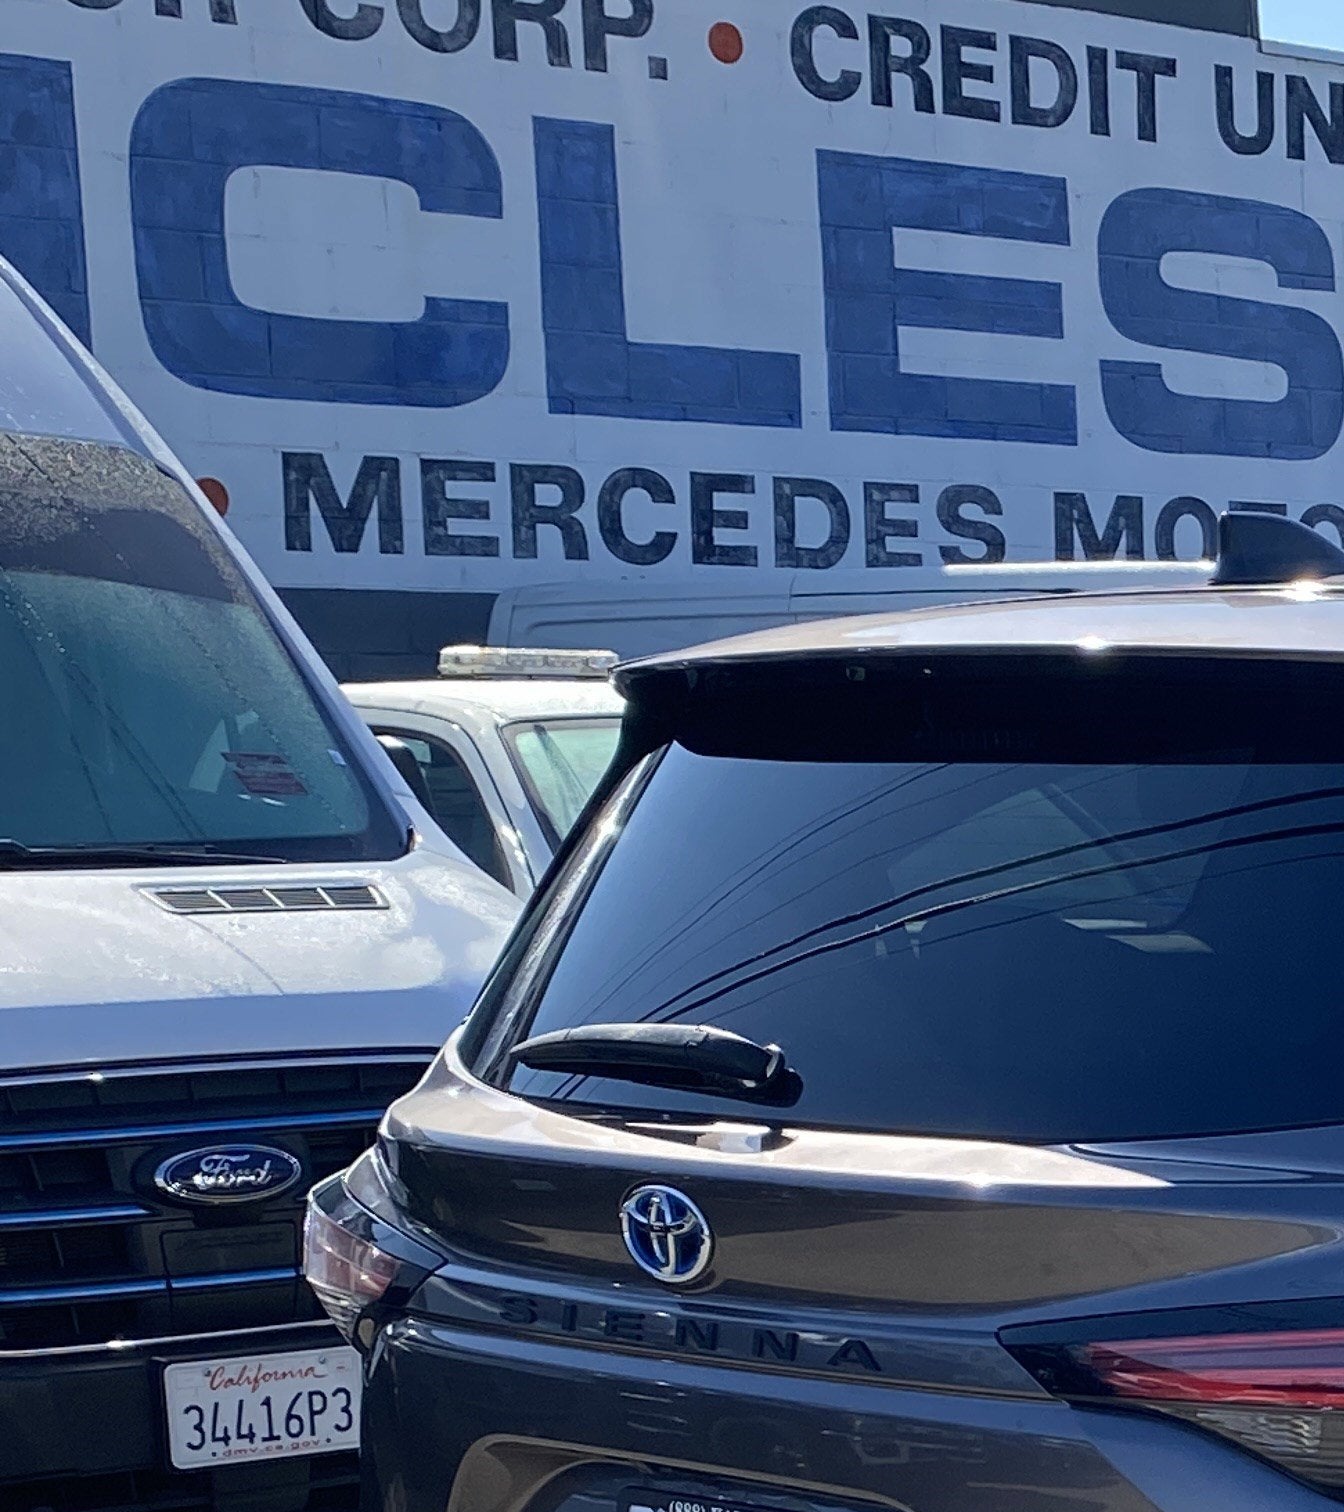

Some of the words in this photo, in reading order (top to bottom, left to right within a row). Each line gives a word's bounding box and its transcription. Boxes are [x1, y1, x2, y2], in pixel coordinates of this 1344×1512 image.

[789, 4, 1177, 143] CREDIT
[280, 451, 1006, 570] MERCEDES
[193, 1154, 273, 1187] Ford
[500, 1295, 883, 1373] SIENNA
[209, 1362, 328, 1394] California
[183, 1386, 354, 1451] 34416P3
[222, 1438, 322, 1458] dmv.ca.gov
